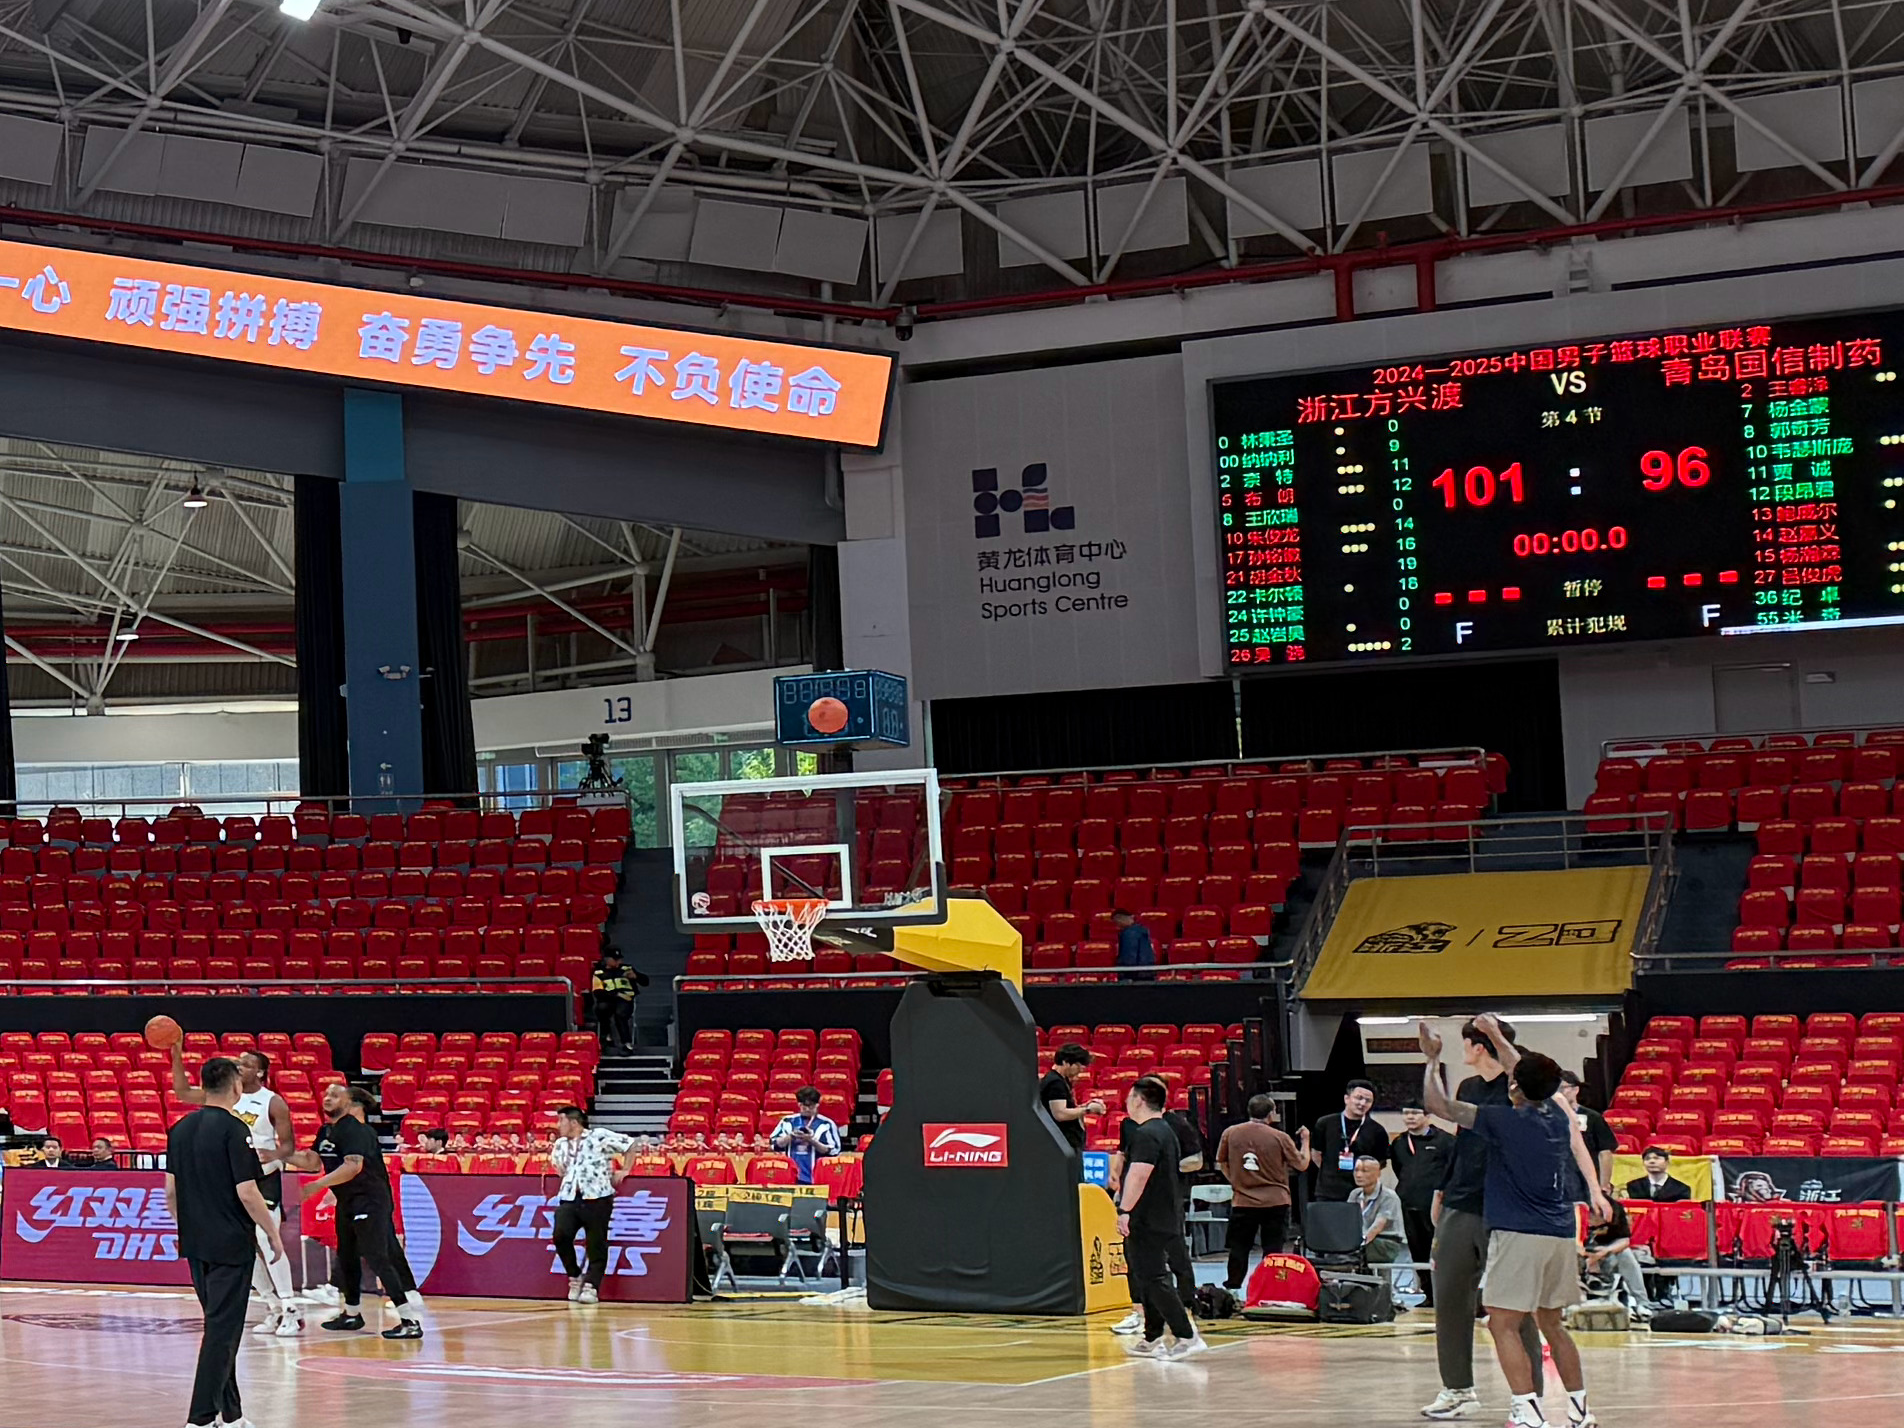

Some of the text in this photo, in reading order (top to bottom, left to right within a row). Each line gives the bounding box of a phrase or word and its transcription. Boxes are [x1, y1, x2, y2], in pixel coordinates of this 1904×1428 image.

[104, 276, 323, 350] 顽强拼搏
[356, 310, 576, 385] 奋勇争先
[613, 344, 842, 418] 不负使命
[1297, 337, 1883, 423] 浙江方兴渡 VS 青岛国信制药
[1741, 383, 1753, 398] 2
[1741, 404, 1754, 418] 7
[1218, 437, 1229, 449] 0
[1388, 419, 1399, 432] 0
[1743, 424, 1755, 439] 8
[1219, 455, 1239, 469] 00
[1389, 439, 1400, 452] 9
[1746, 444, 1768, 459] 10
[1220, 457, 1410, 488] 2 11
[1432, 445, 1711, 508] 101 96
[1748, 465, 1768, 480] 11
[1222, 478, 1413, 507] 5 12
[1749, 486, 1771, 502] 12
[1223, 513, 1233, 526] 8
[1393, 497, 1404, 511] 0
[1752, 507, 1773, 521] 13
[1226, 531, 1244, 545] 10
[1395, 517, 1415, 530] 14
[1513, 526, 1628, 556] 00:00.0
[1752, 528, 1773, 542] 14
[976, 538, 1127, 572] 黄龙体育中心
[1227, 551, 1243, 565] 17
[1396, 537, 1417, 550] 16
[1754, 549, 1776, 563] 15
[980, 571, 1101, 594] Huanglong
[1226, 571, 1244, 585] 21
[1397, 557, 1418, 570] 19
[1754, 569, 1776, 584] 27
[1227, 590, 1247, 604] 22
[1399, 577, 1419, 590] 18
[1562, 578, 1603, 599] 暂停
[1755, 590, 1778, 606] 36
[981, 592, 1129, 622] Sports Centre
[1228, 610, 1247, 623] 24
[1399, 597, 1410, 610] 0
[1756, 611, 1779, 625] 55
[1229, 629, 1250, 643] 25
[1400, 617, 1411, 631] 0
[1455, 603, 1721, 645] F F
[1546, 614, 1628, 636] 累计犯规
[1230, 637, 1412, 663] 26 2
[603, 696, 632, 724] 13
[929, 1149, 1004, 1166] LI-NING
[18, 1185, 180, 1241] 红双喜
